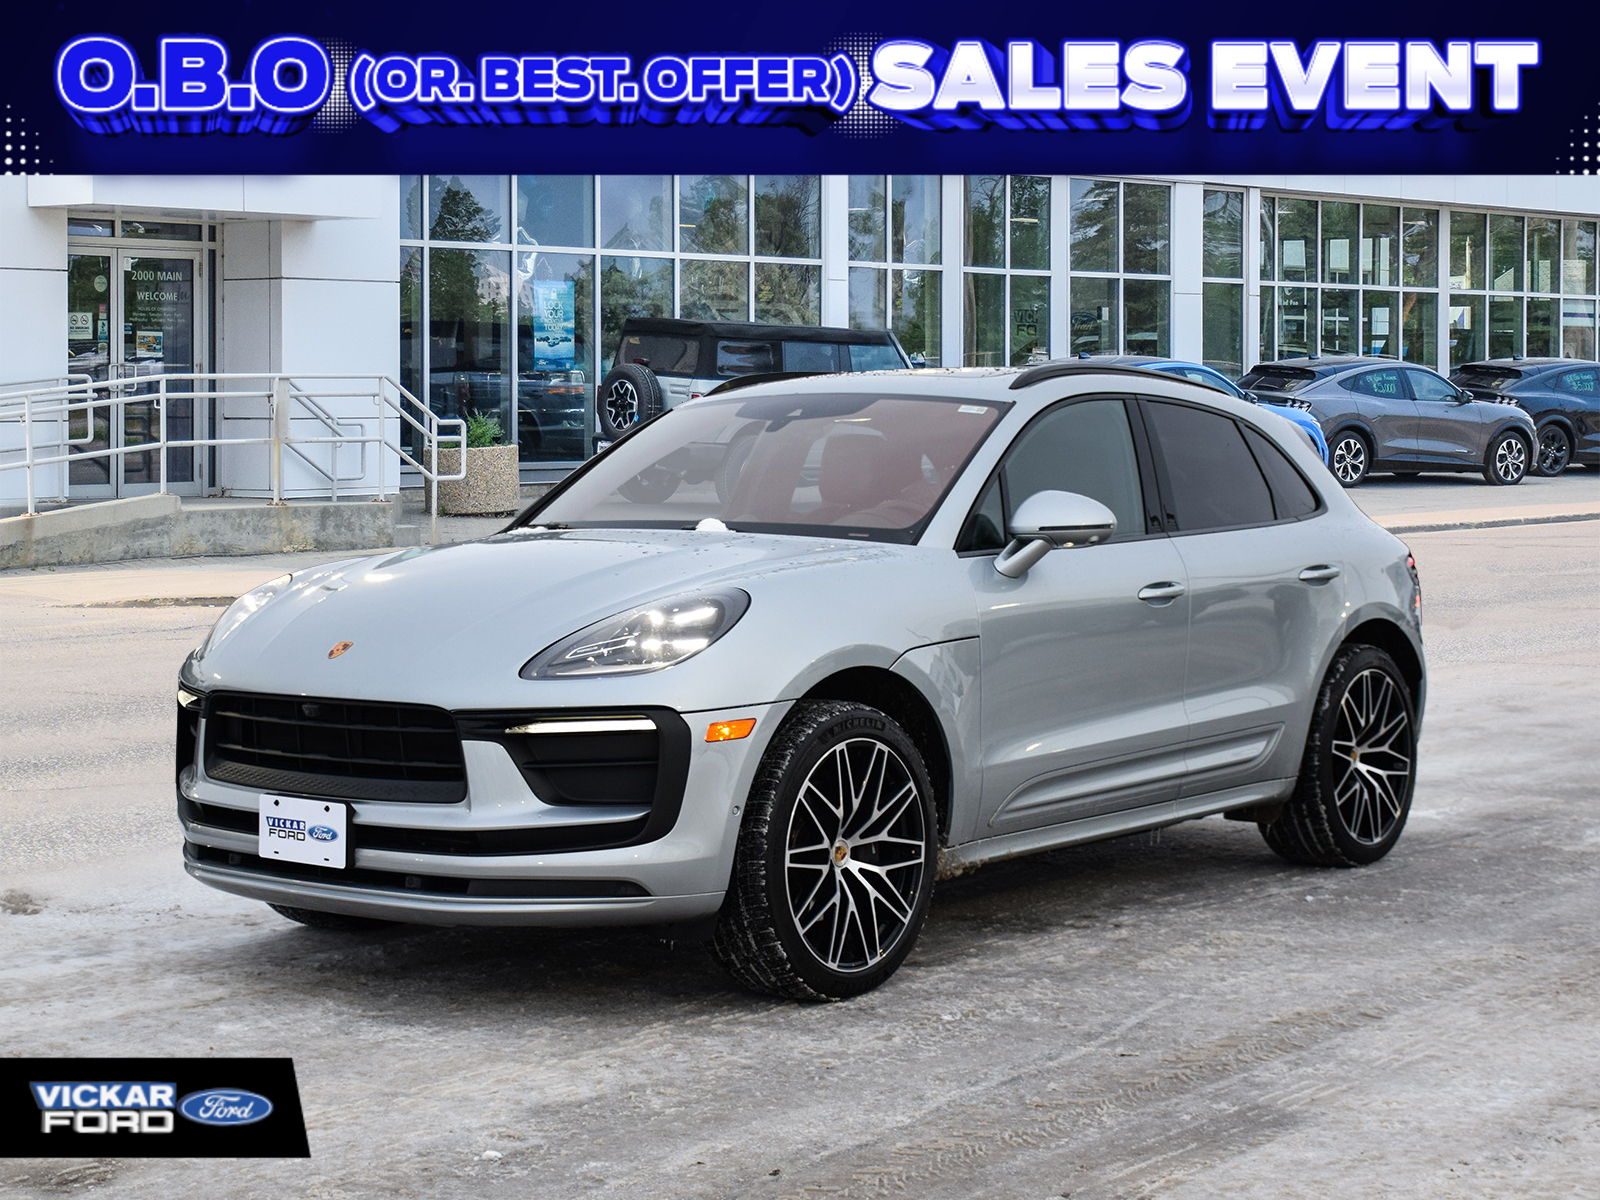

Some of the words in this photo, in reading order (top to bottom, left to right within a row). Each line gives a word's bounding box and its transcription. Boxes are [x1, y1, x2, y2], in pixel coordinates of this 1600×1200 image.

[131, 270, 155, 281] 2000
[157, 271, 183, 282] MAIN
[136, 291, 178, 301] WELCOME
[544, 310, 564, 318] YOUR
[833, 718, 883, 733] MICHELIN
[268, 817, 305, 830] VICKAR
[269, 828, 306, 841] FORD
[312, 826, 332, 840] Ford
